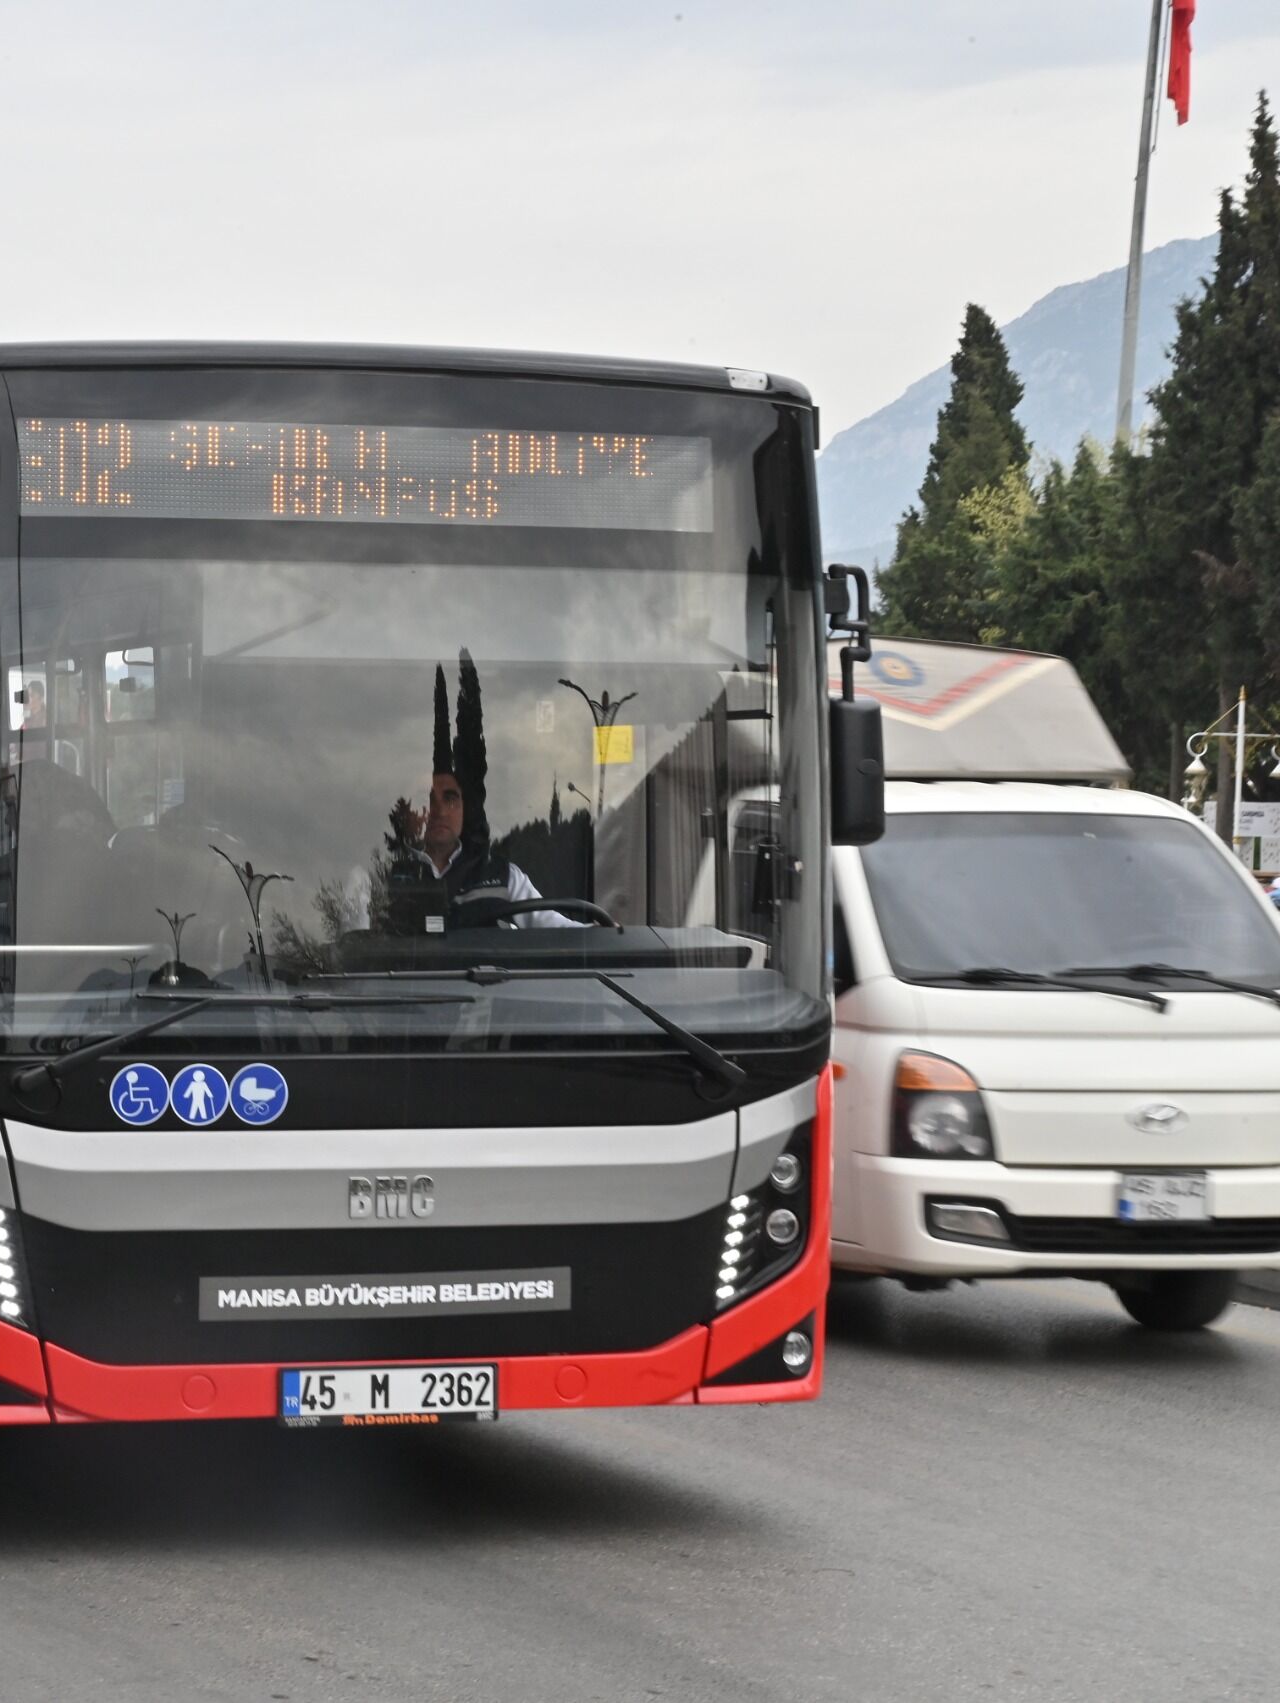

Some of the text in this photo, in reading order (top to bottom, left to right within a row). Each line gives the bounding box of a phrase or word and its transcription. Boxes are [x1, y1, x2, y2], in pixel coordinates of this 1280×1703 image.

[348, 1174, 435, 1219] BMC
[300, 1372, 491, 1411] 45 M 2362
